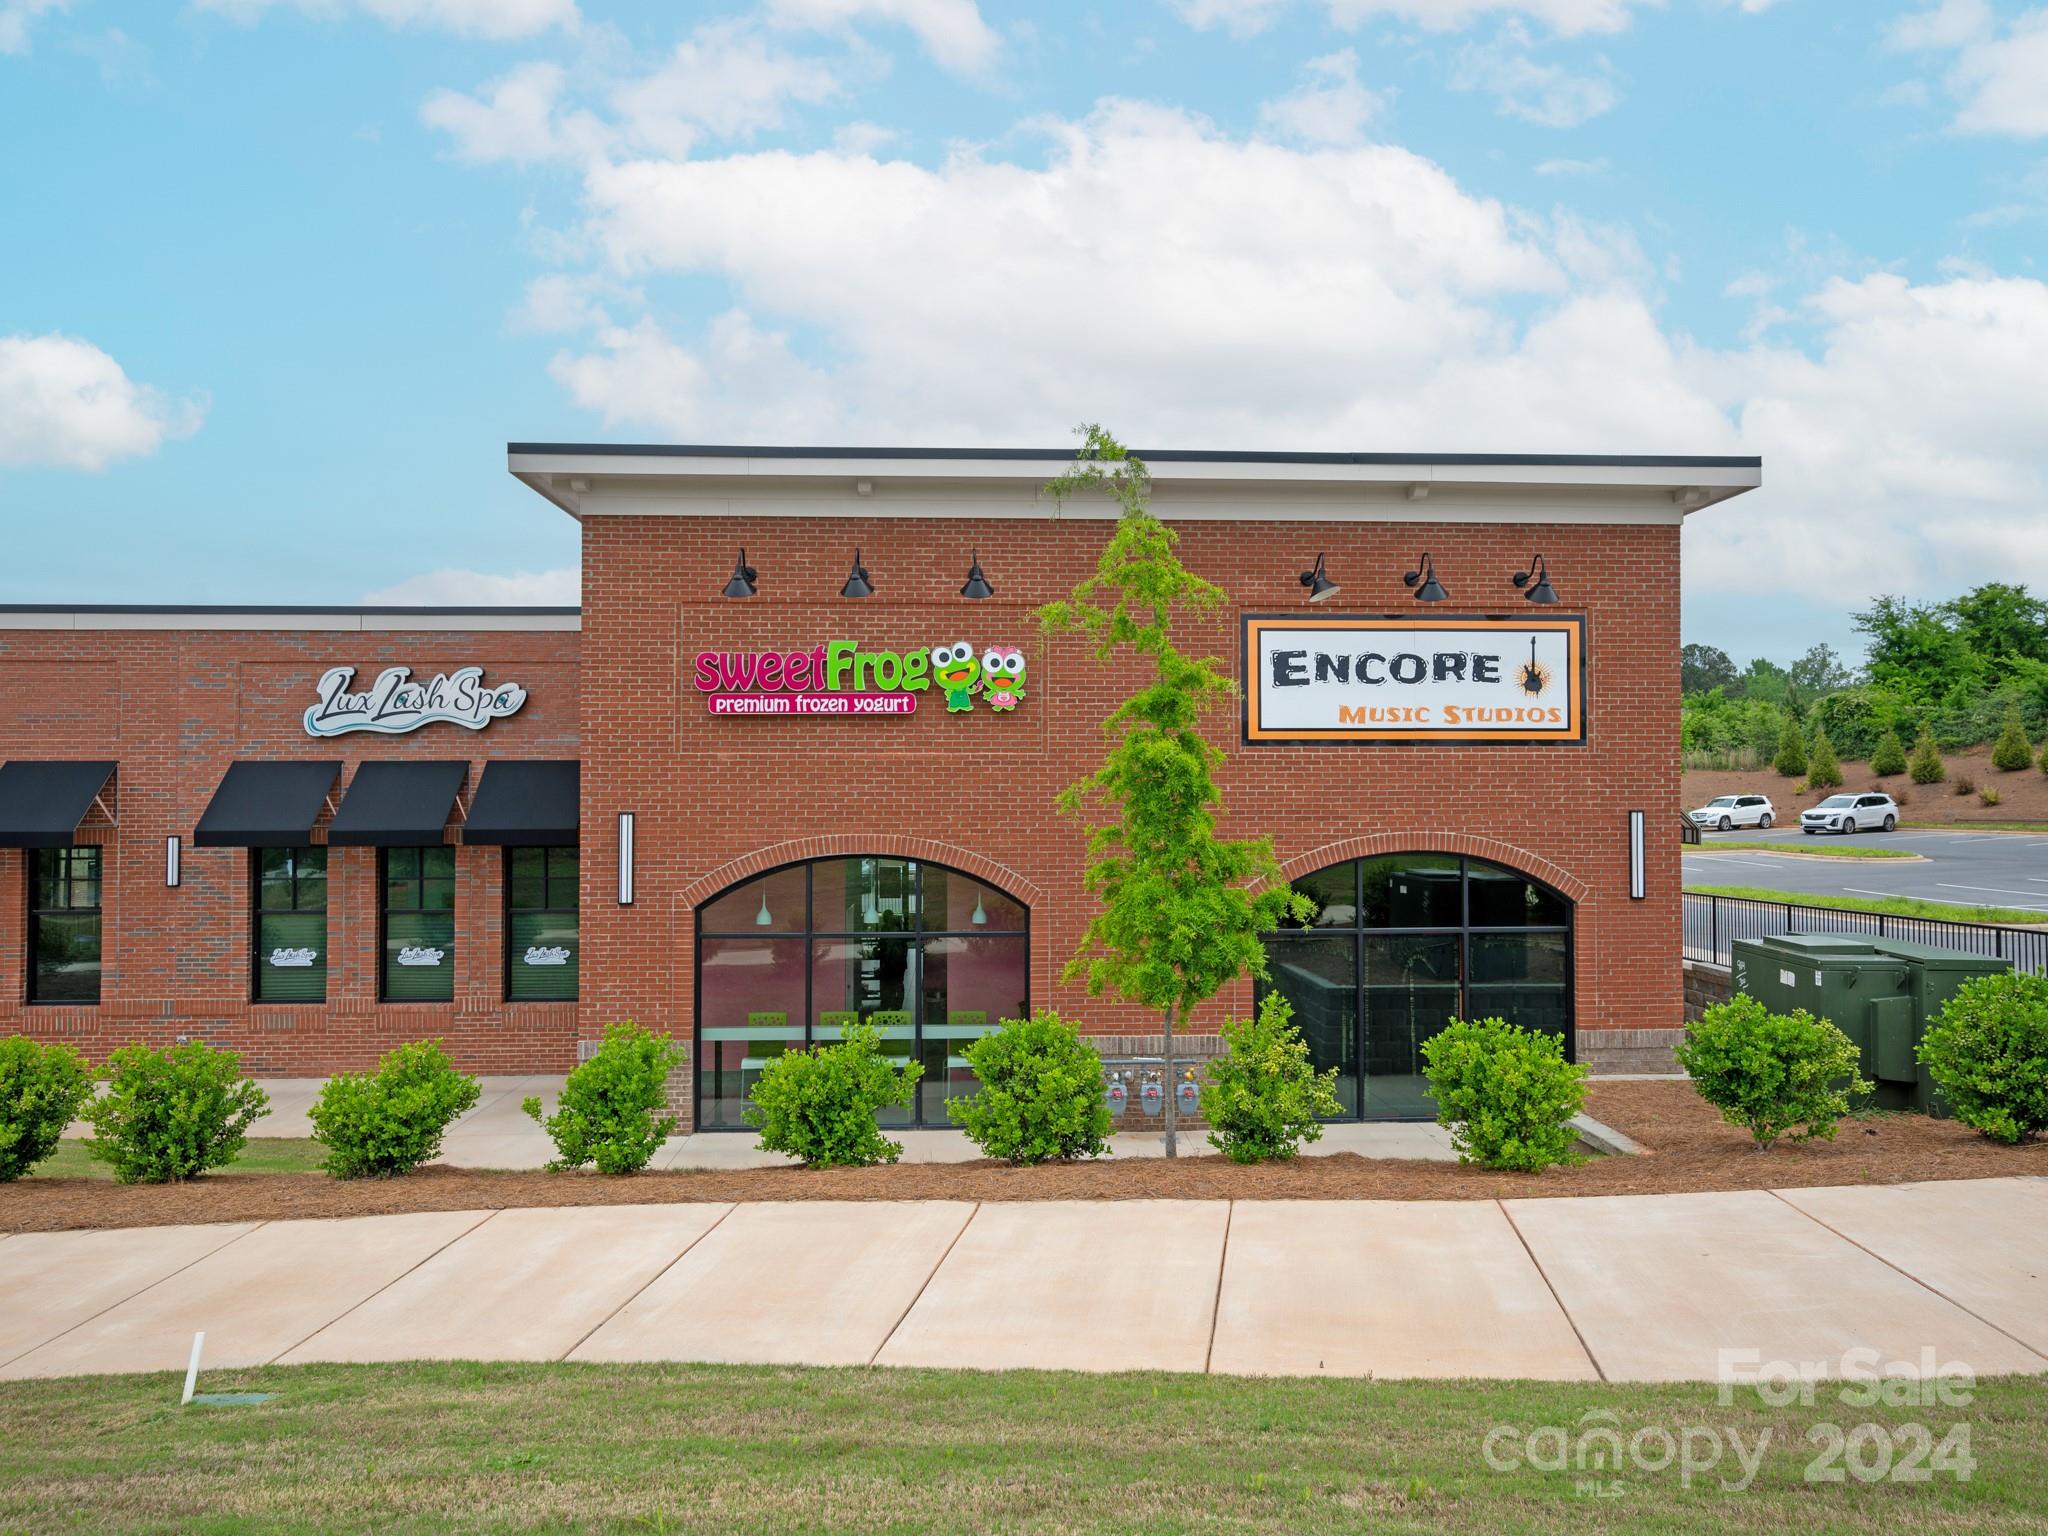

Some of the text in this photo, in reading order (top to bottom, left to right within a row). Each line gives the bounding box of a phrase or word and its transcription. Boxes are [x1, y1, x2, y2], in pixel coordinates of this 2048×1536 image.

[694, 640, 931, 692] sweetFrog
[1271, 650, 1503, 688] ENCORE
[315, 674, 514, 722] Lux Lash Spa
[715, 695, 909, 713] premium frozen yogurt
[1338, 704, 1562, 724] MUSIC STUDIOS
